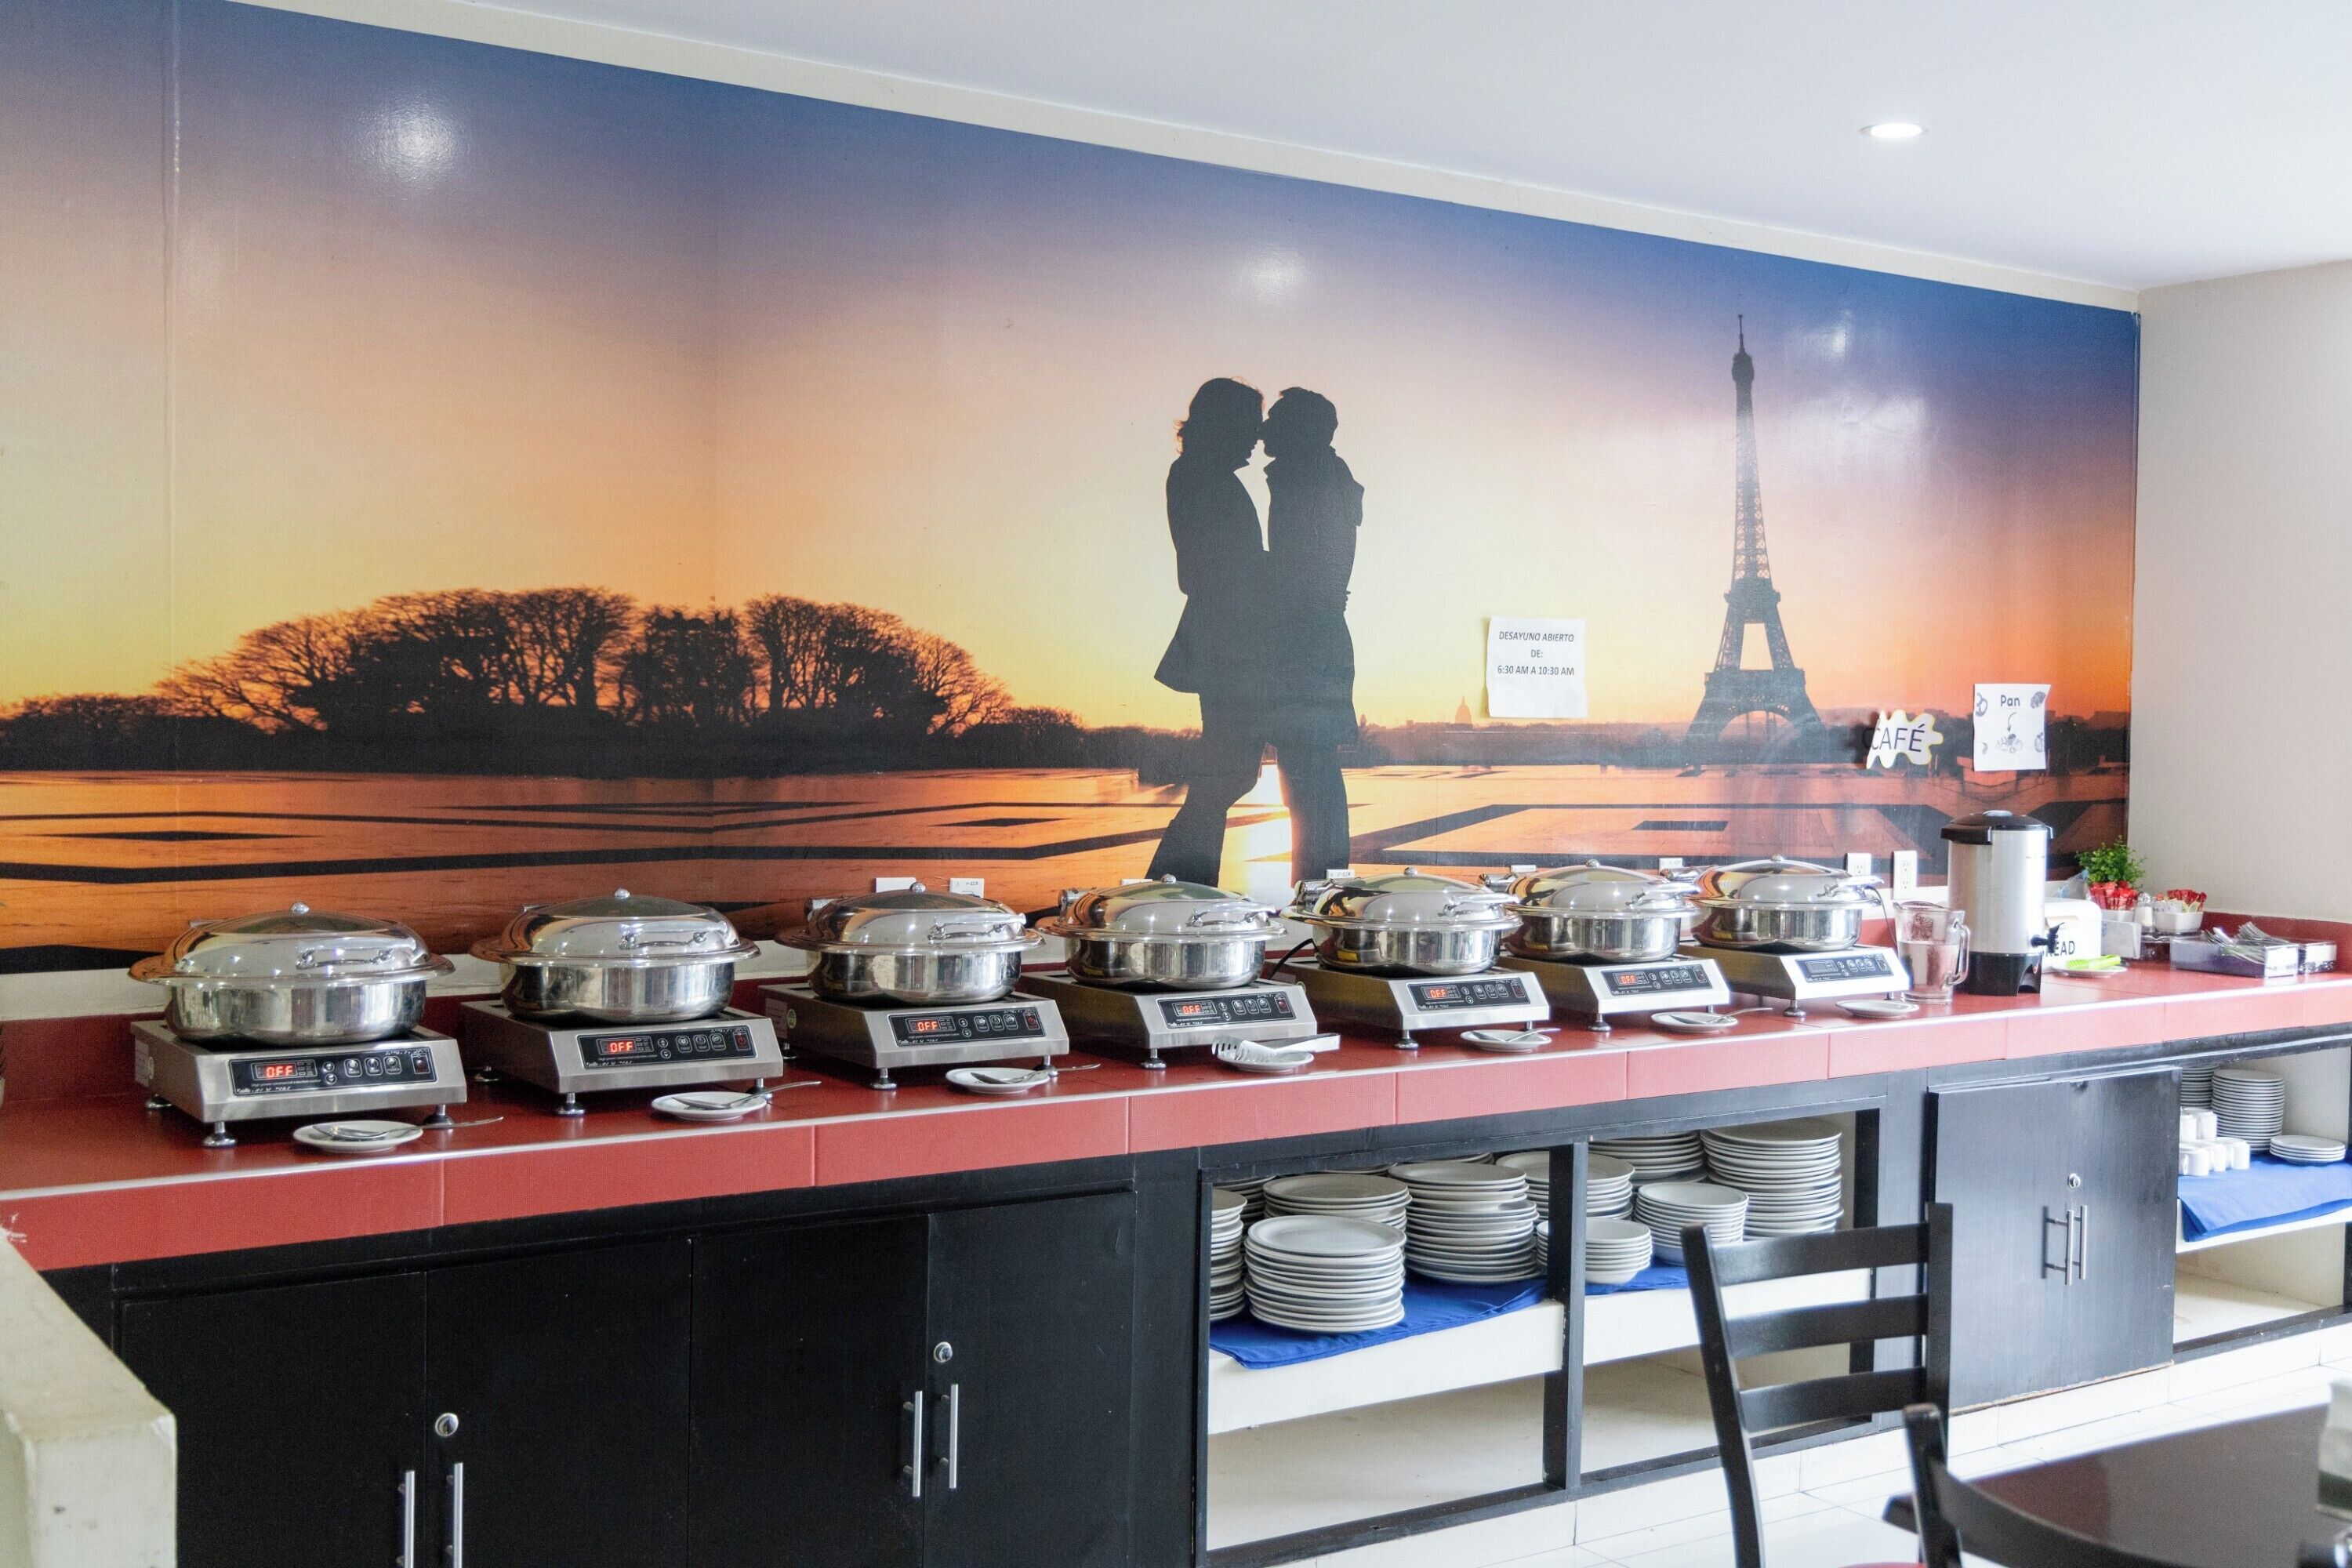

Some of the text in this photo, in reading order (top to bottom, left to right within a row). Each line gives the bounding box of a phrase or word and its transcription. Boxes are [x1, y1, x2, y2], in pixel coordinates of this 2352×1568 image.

[1498, 630, 1574, 642] DESAYUNO ABIERTO
[1530, 649, 1543, 658] DE:
[1497, 665, 1574, 676] 6:30 AM A 10:30 AM
[2000, 695, 2020, 707] Pan
[1429, 989, 1446, 999] OFF
[1181, 1004, 1200, 1014] OFF
[916, 1020, 938, 1032] OFF
[609, 1041, 635, 1053] OFF
[266, 1065, 293, 1079] OFF
